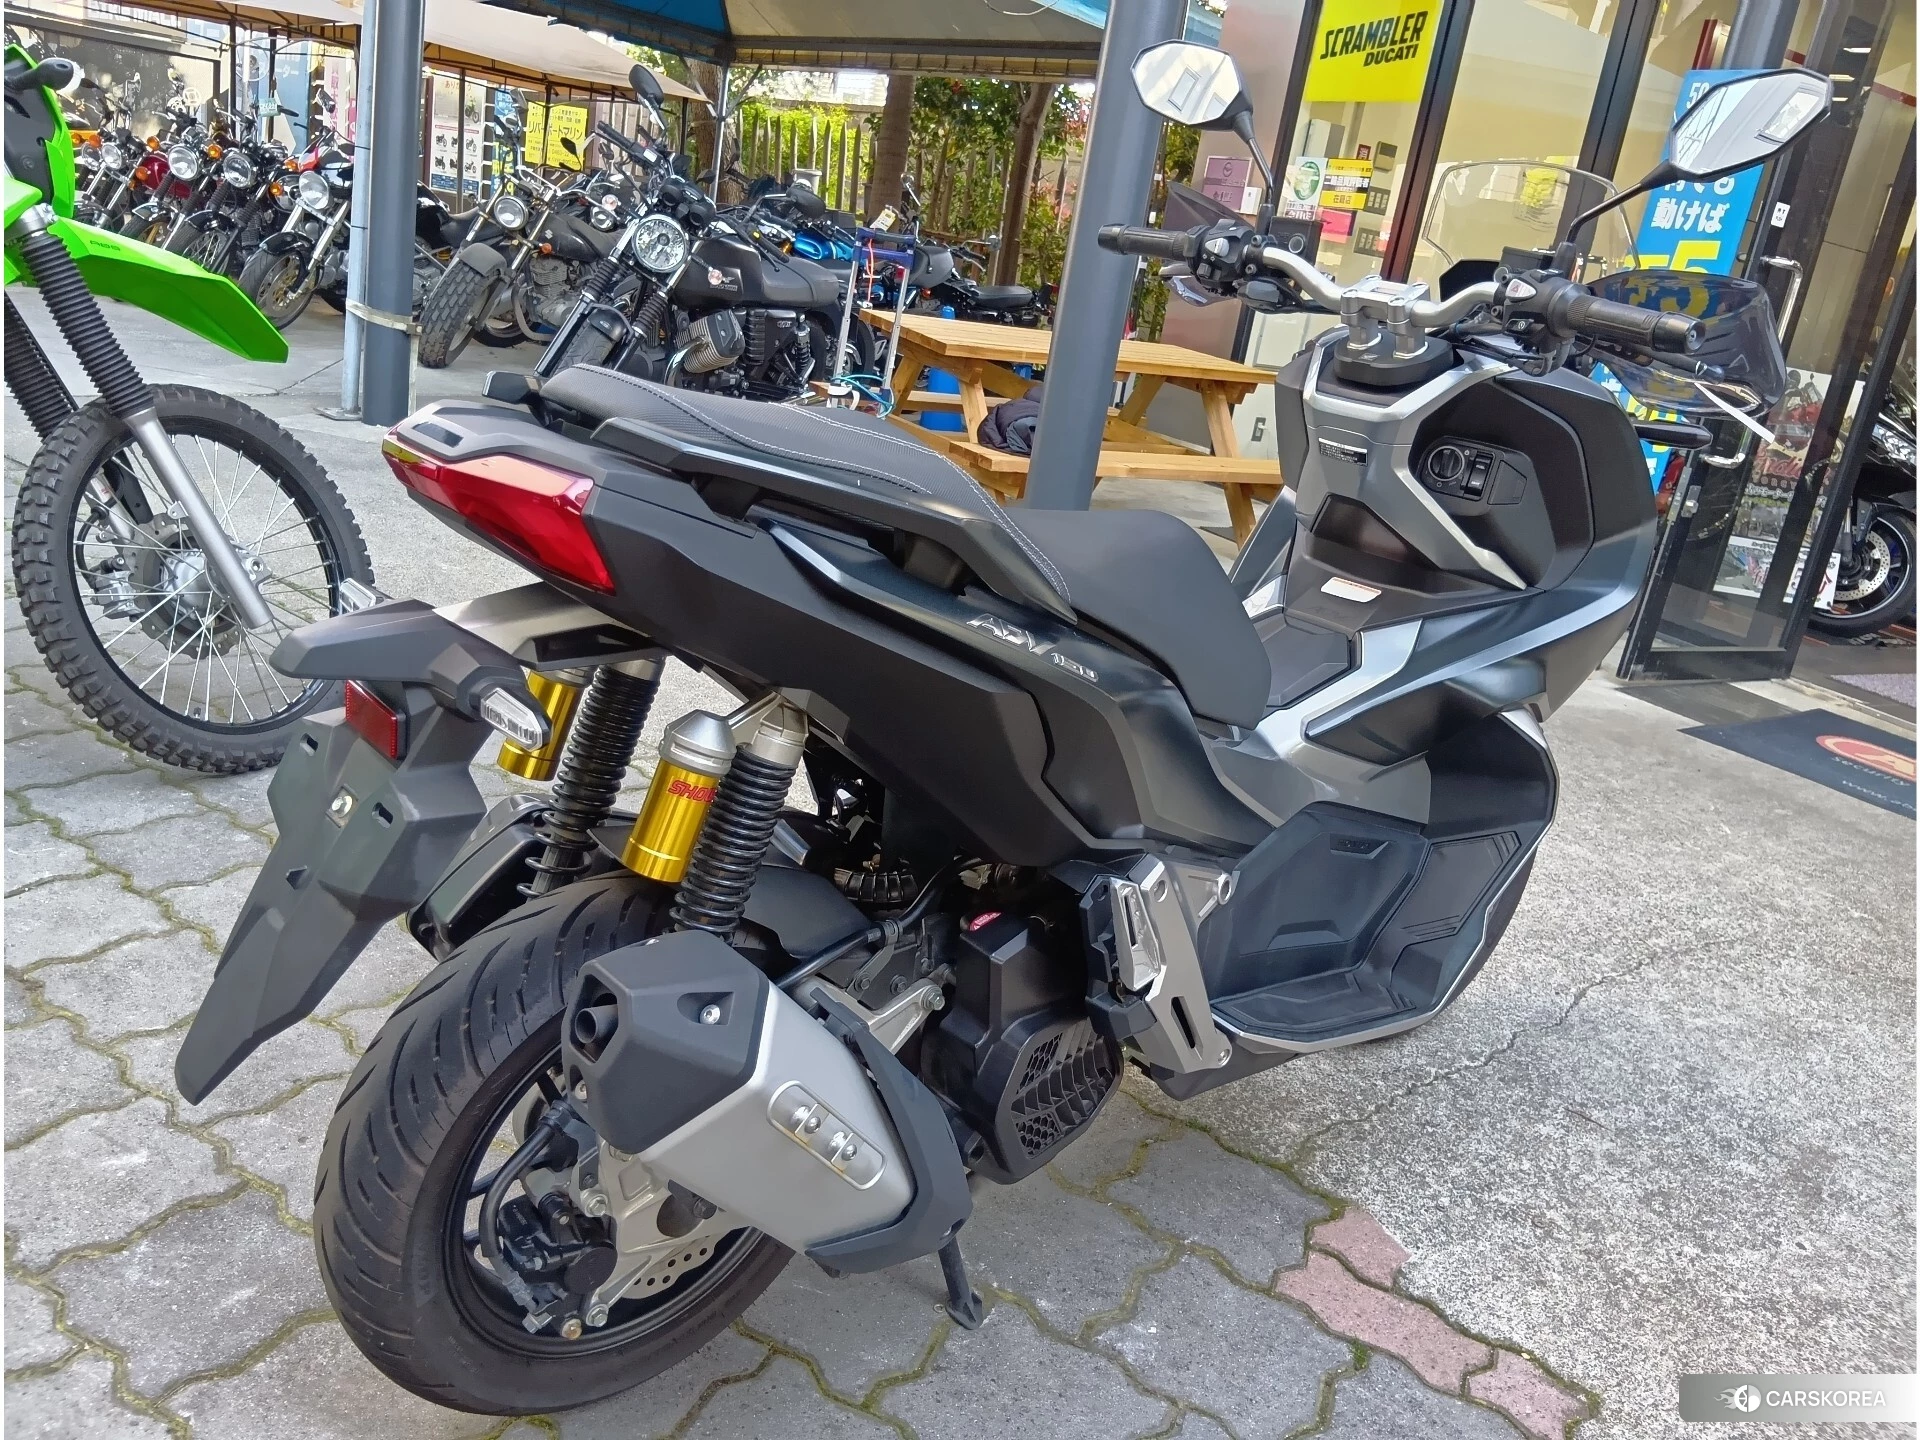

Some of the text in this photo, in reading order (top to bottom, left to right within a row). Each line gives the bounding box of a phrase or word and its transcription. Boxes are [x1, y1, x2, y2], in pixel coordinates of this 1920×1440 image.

[1320, 11, 1428, 59] SCRAMBLER
[1363, 44, 1419, 67] DUCATI
[1651, 197, 1730, 233] 動けば
[966, 613, 1056, 656] ADV
